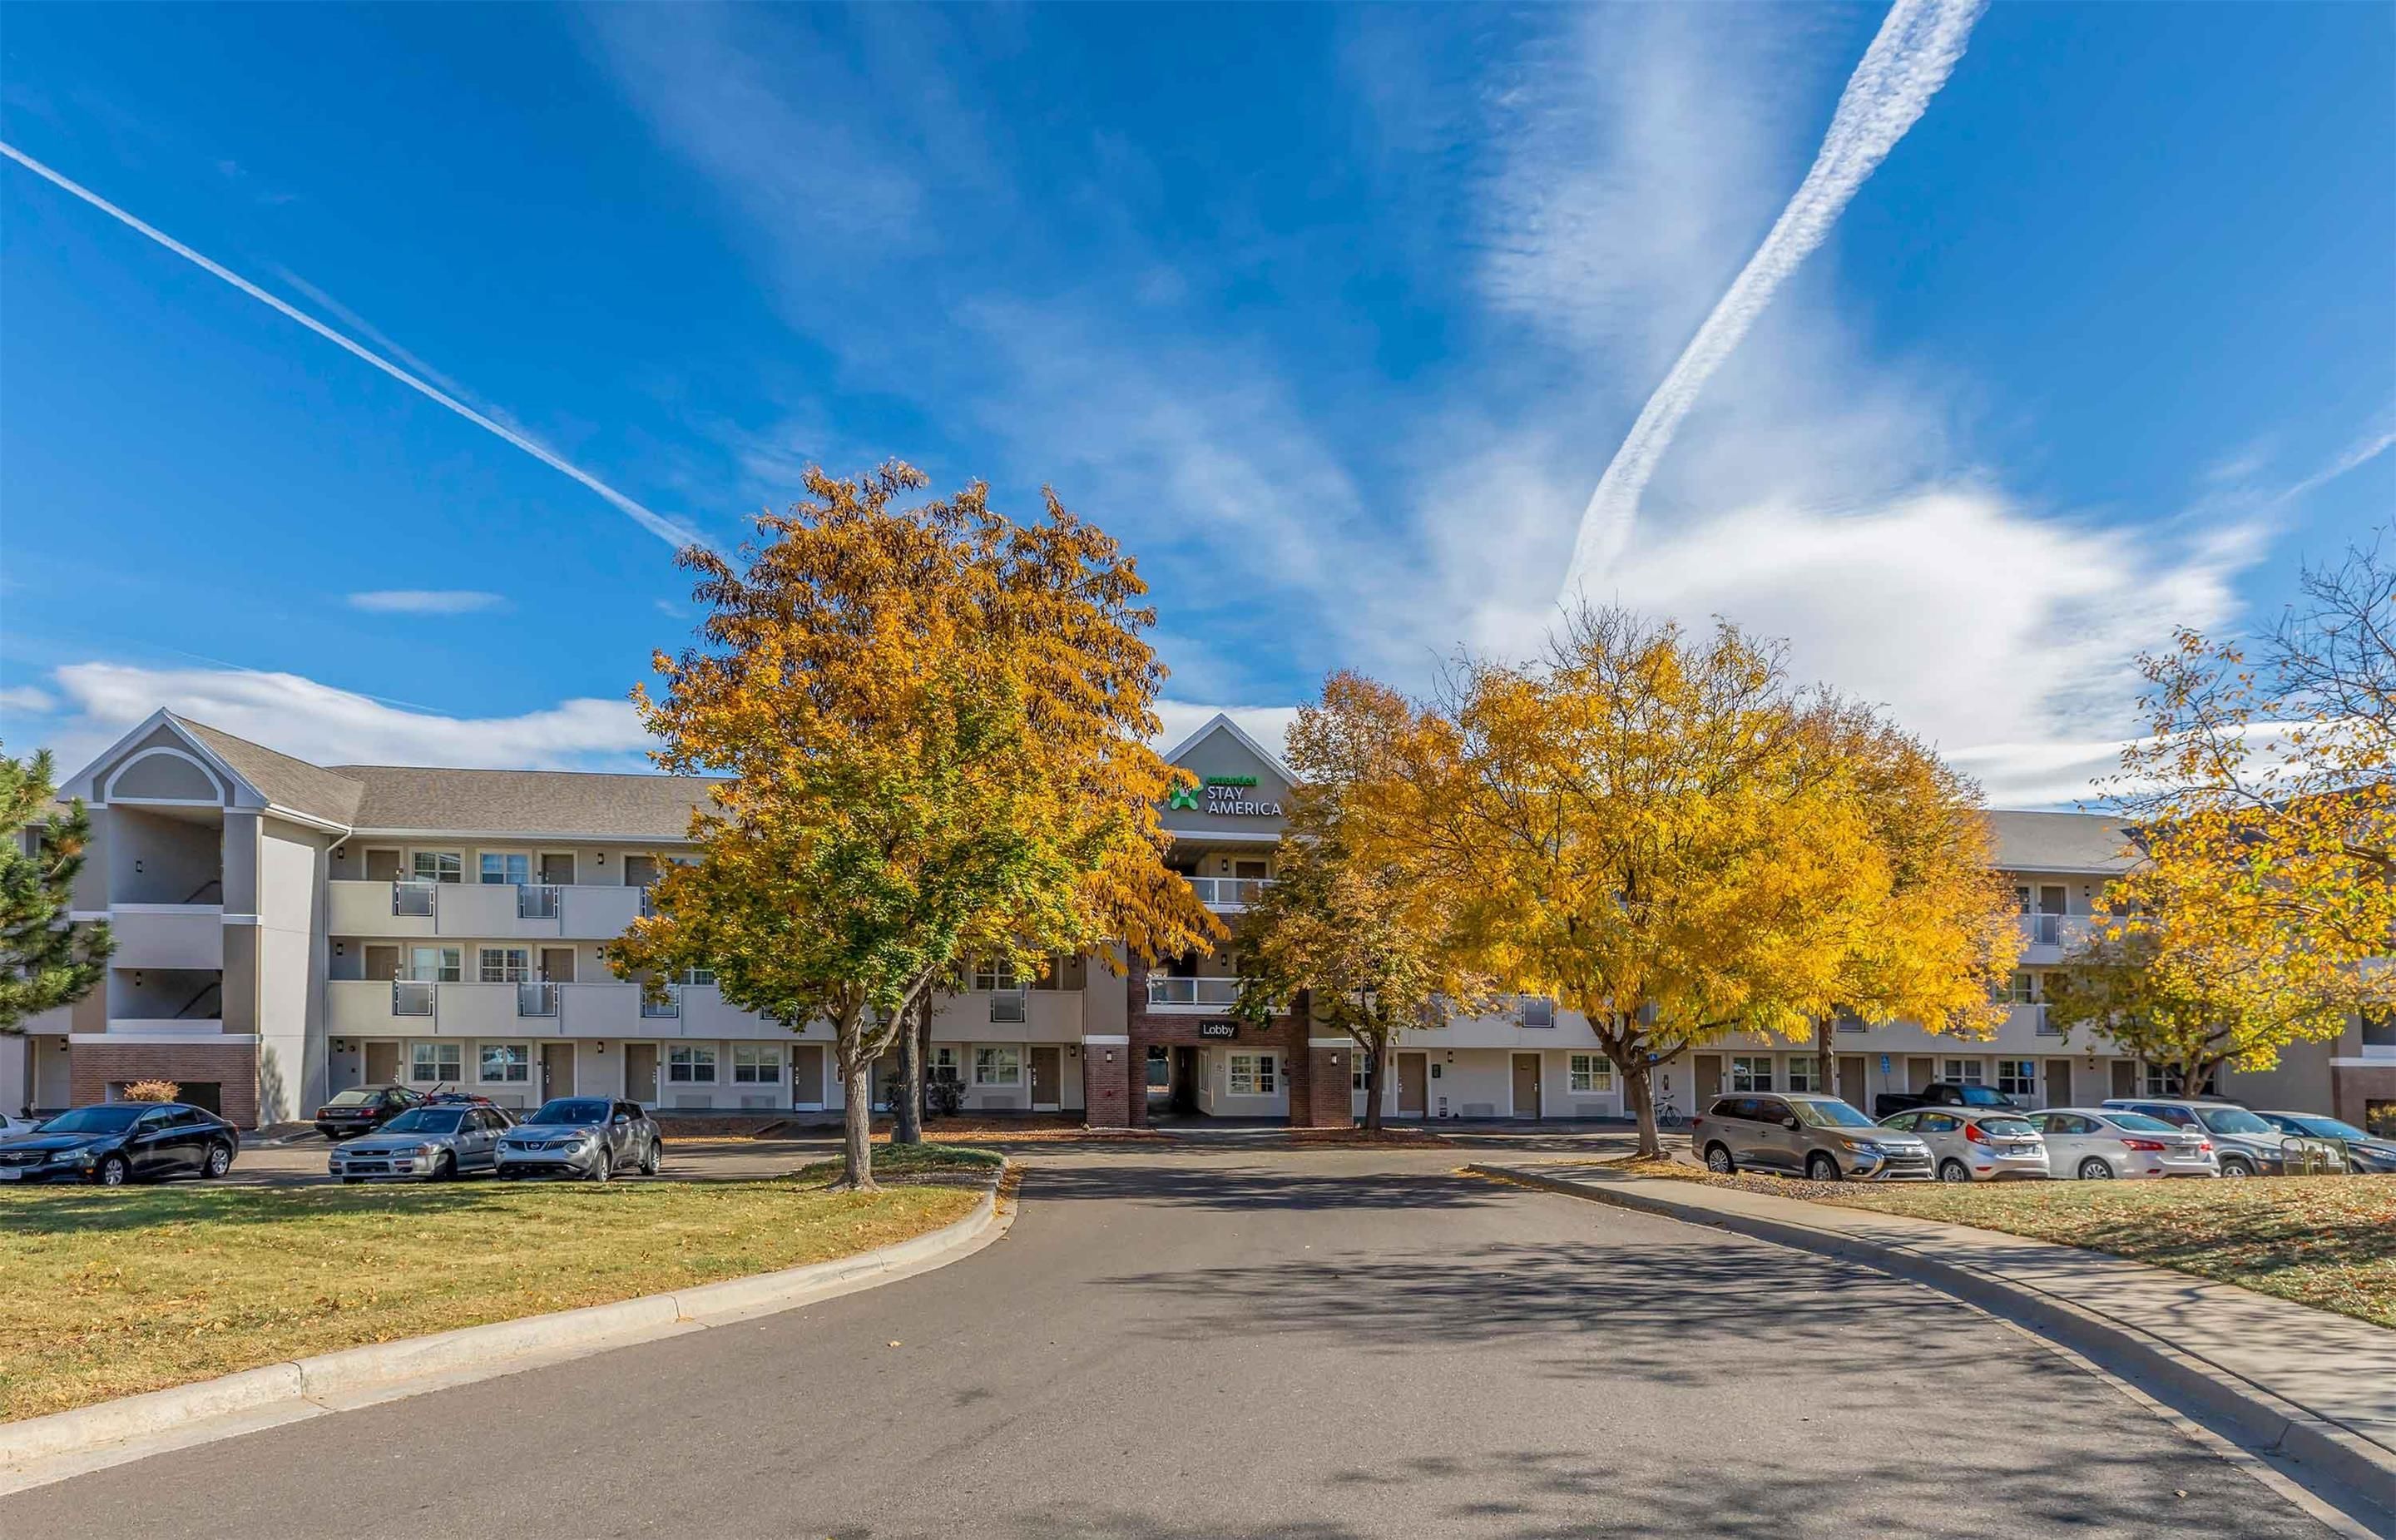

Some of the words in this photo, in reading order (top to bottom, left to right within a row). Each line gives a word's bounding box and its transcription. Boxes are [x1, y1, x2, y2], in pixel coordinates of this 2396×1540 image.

[1208, 786, 1244, 799] STAY
[1208, 801, 1282, 815] AMERICA
[1203, 1024, 1235, 1037] Lobby
